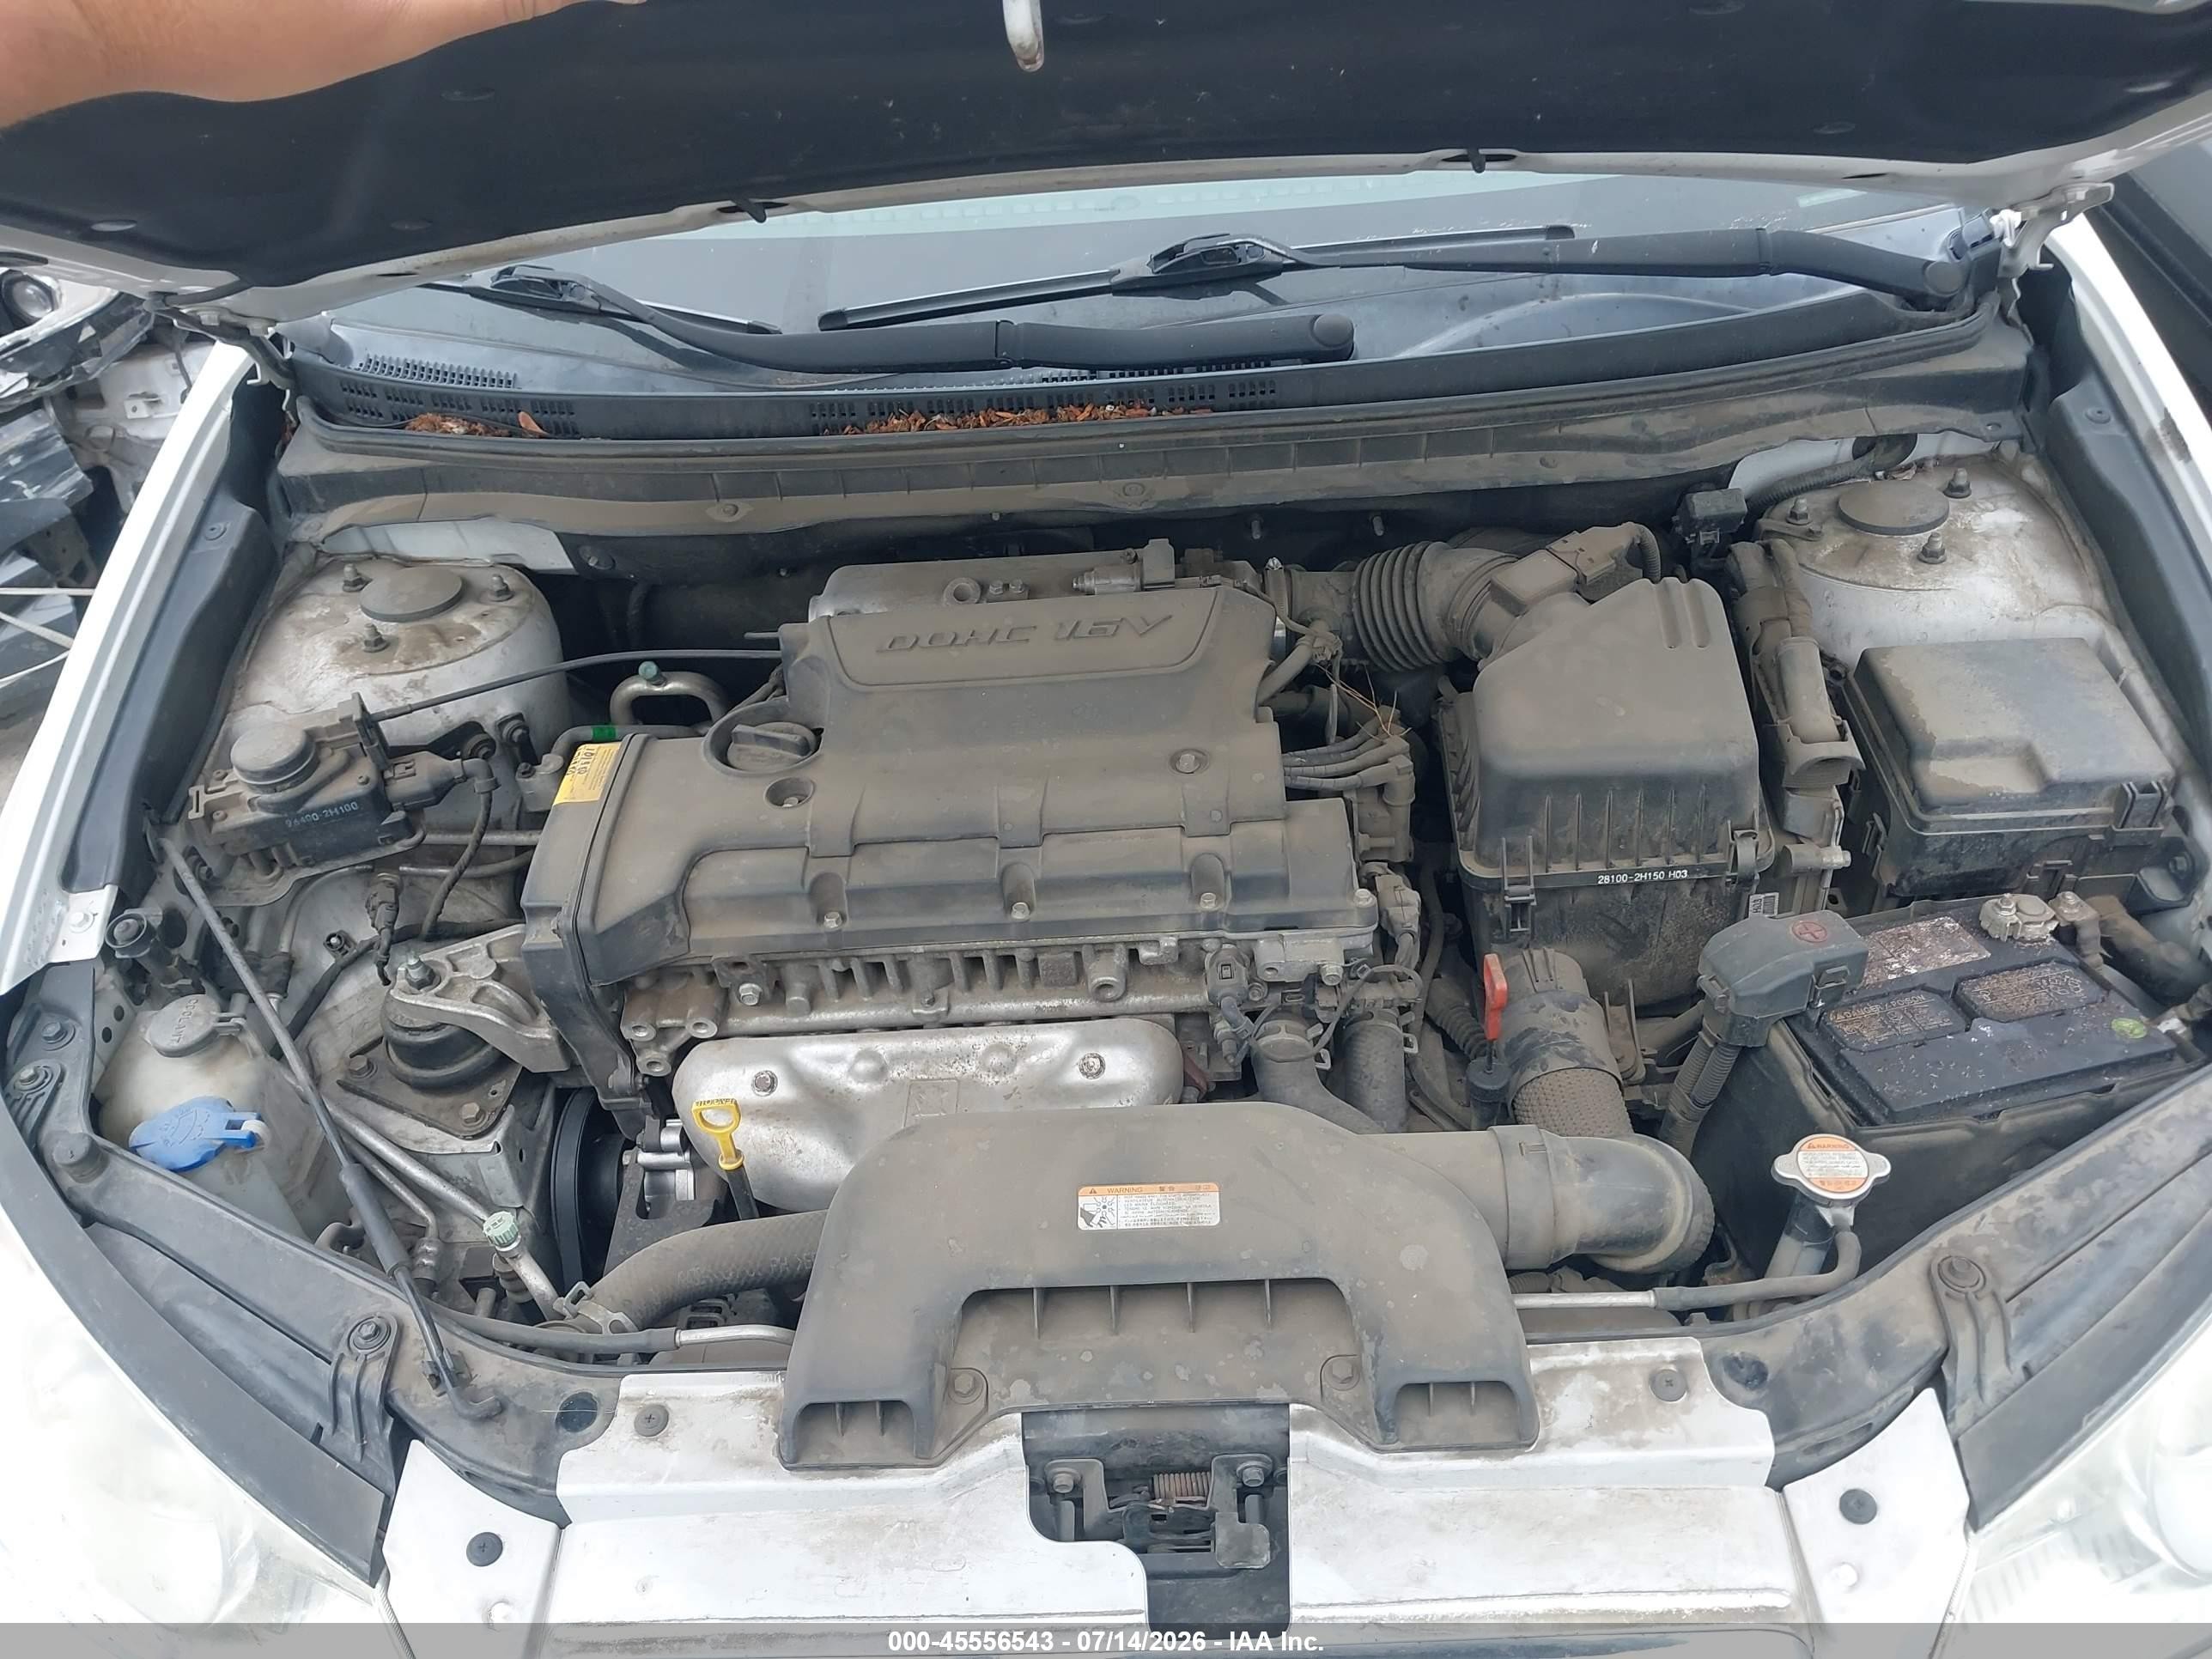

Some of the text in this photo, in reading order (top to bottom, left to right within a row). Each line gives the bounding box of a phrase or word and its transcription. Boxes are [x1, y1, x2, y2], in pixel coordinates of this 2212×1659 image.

[877, 614, 1174, 653] DOHC 16V
[1597, 870, 1688, 884] 28100-2H150 H03
[1891, 994, 1925, 1007] POISON
